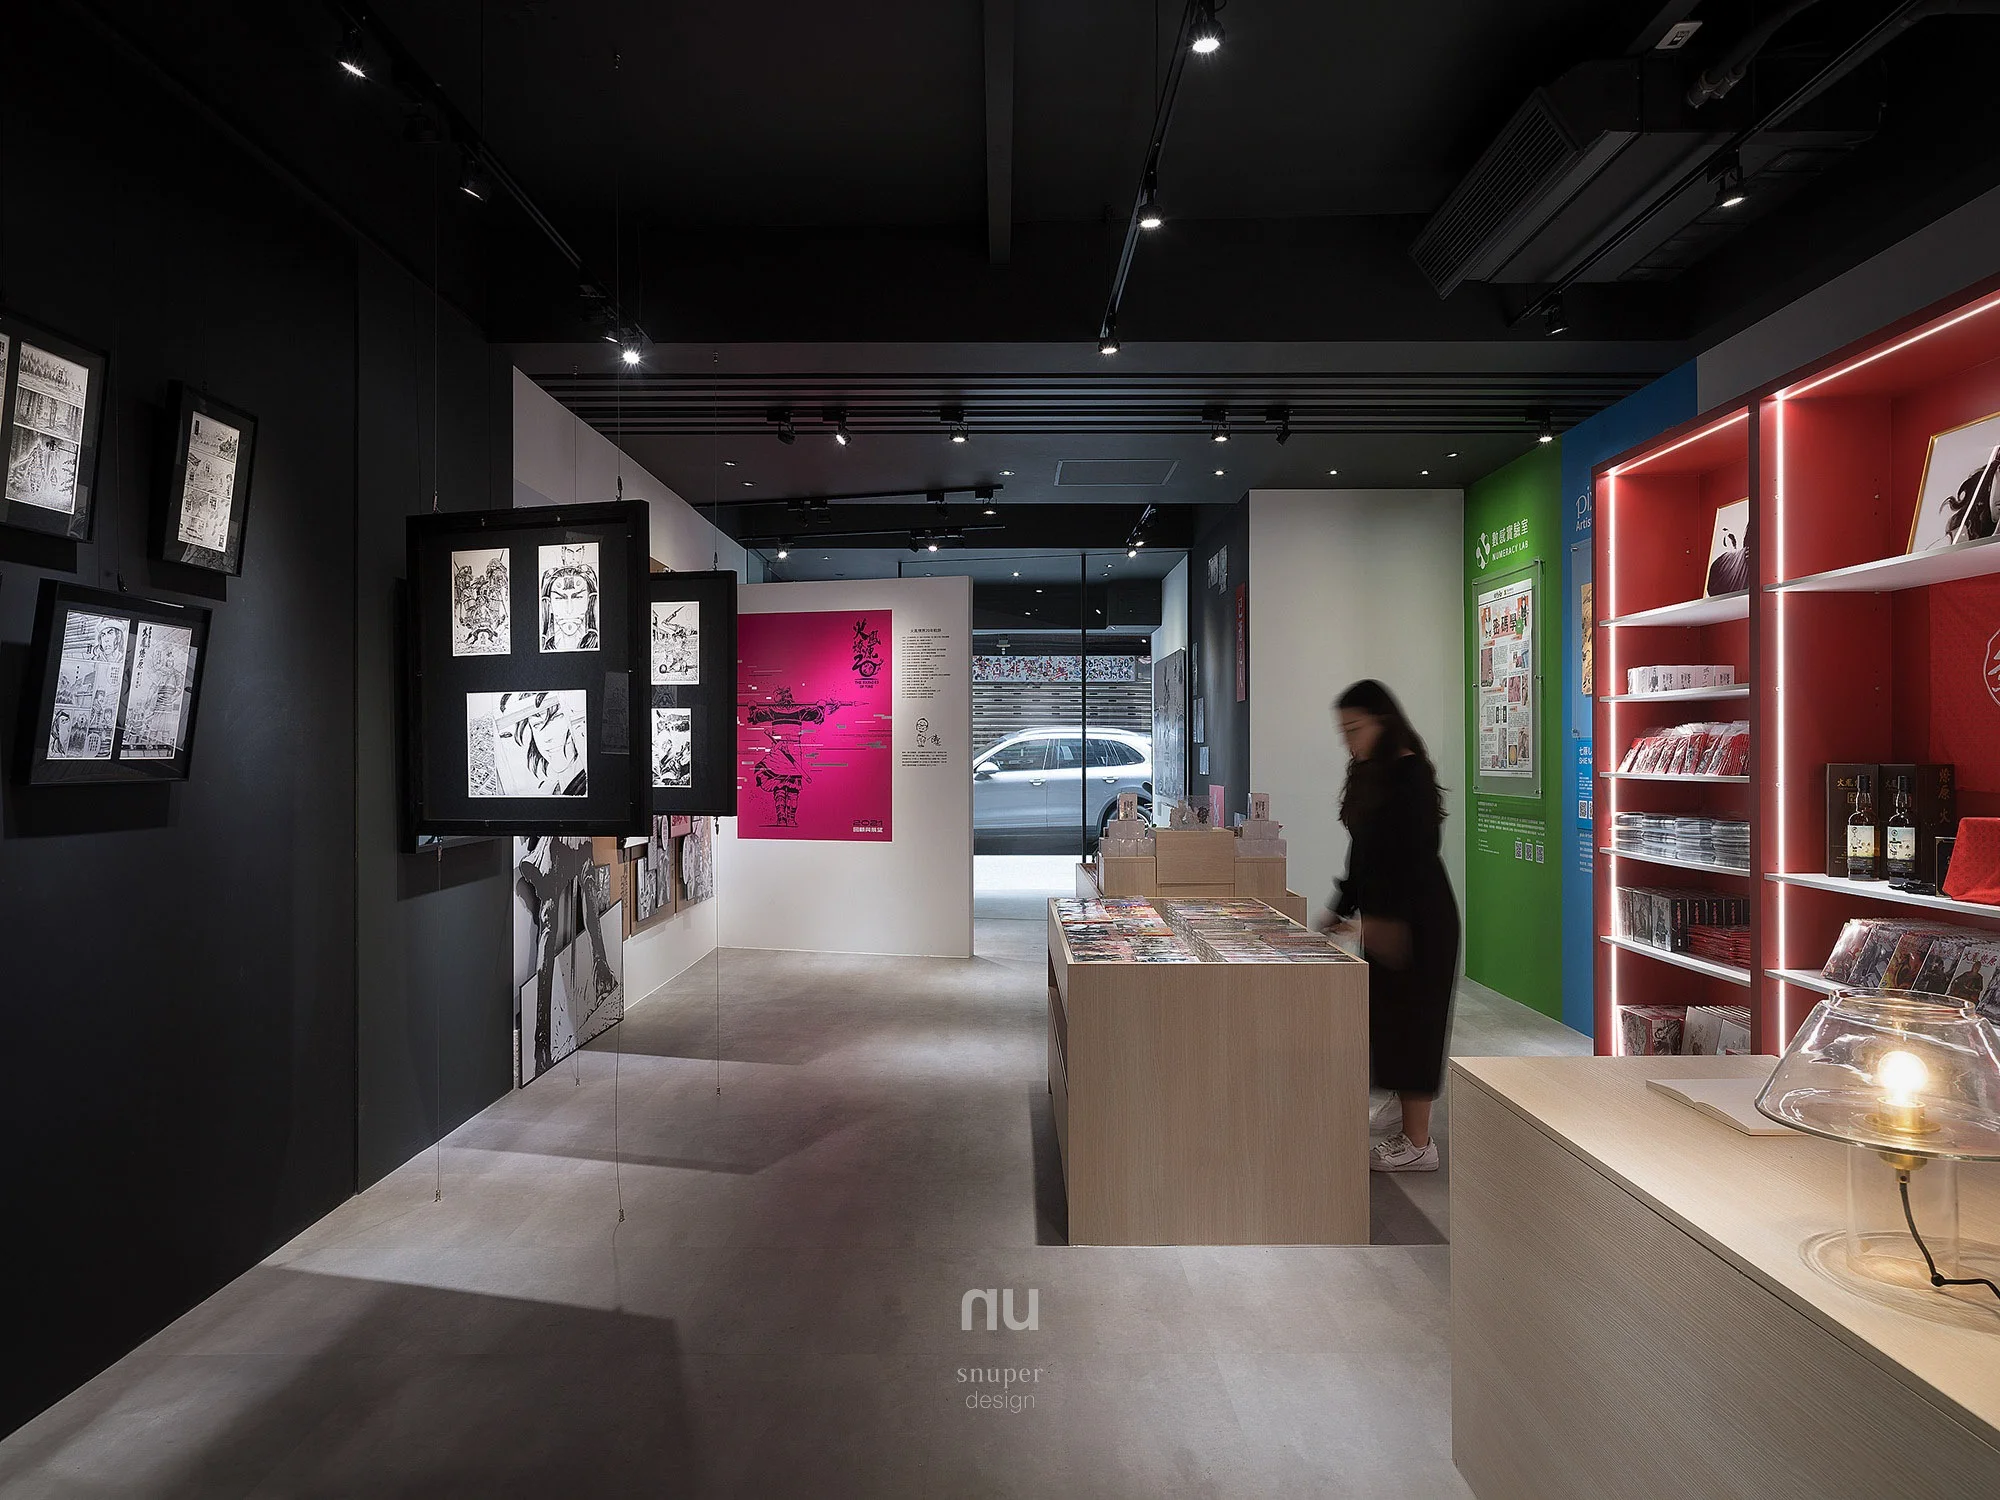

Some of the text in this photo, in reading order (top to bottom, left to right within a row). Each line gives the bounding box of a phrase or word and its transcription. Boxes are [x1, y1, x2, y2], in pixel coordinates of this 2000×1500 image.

[1491, 518, 1529, 548] 數感實驗室
[1492, 540, 1529, 561] NUMERACY LAB
